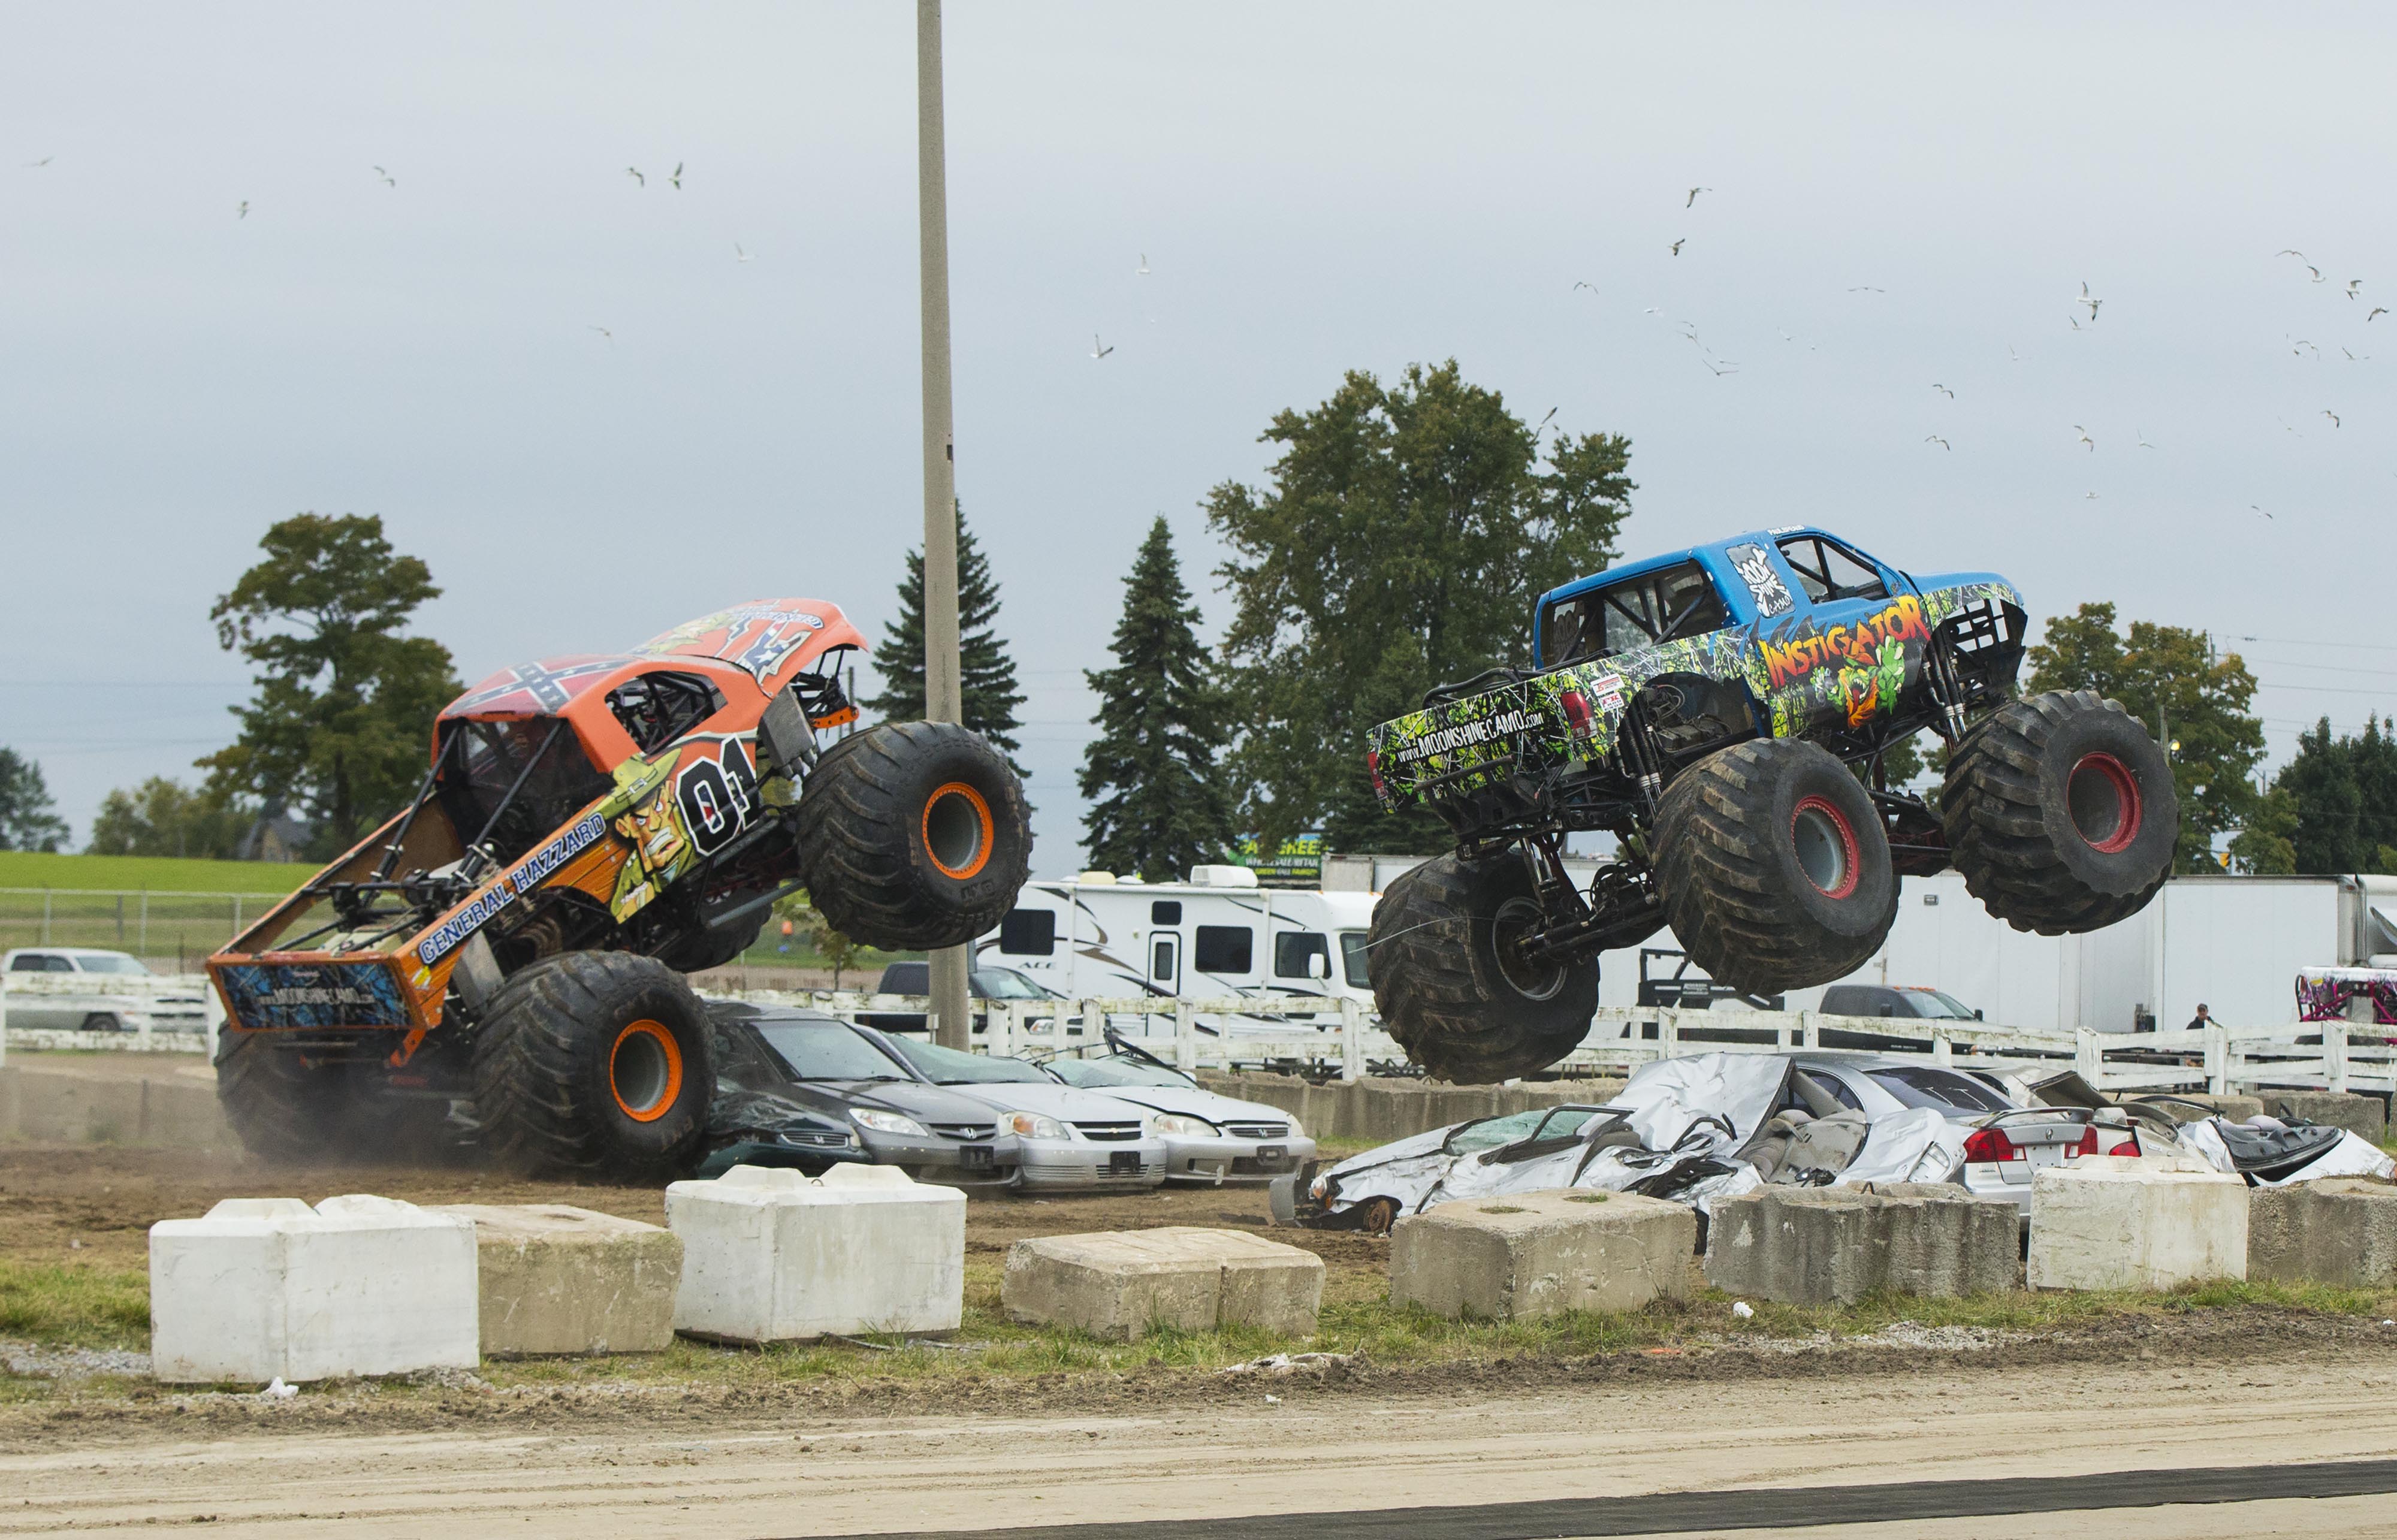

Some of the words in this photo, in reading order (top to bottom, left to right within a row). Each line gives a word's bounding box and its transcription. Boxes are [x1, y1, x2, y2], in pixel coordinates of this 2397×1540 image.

[1740, 558, 1771, 585] MOON
[1749, 573, 1786, 603] SHINE
[1768, 595, 1791, 614] CAMO
[1756, 595, 1931, 689] INSTIGATOR
[675, 733, 758, 857] 01
[418, 883, 515, 965] GENERAL
[511, 813, 606, 894] HAZZARD
